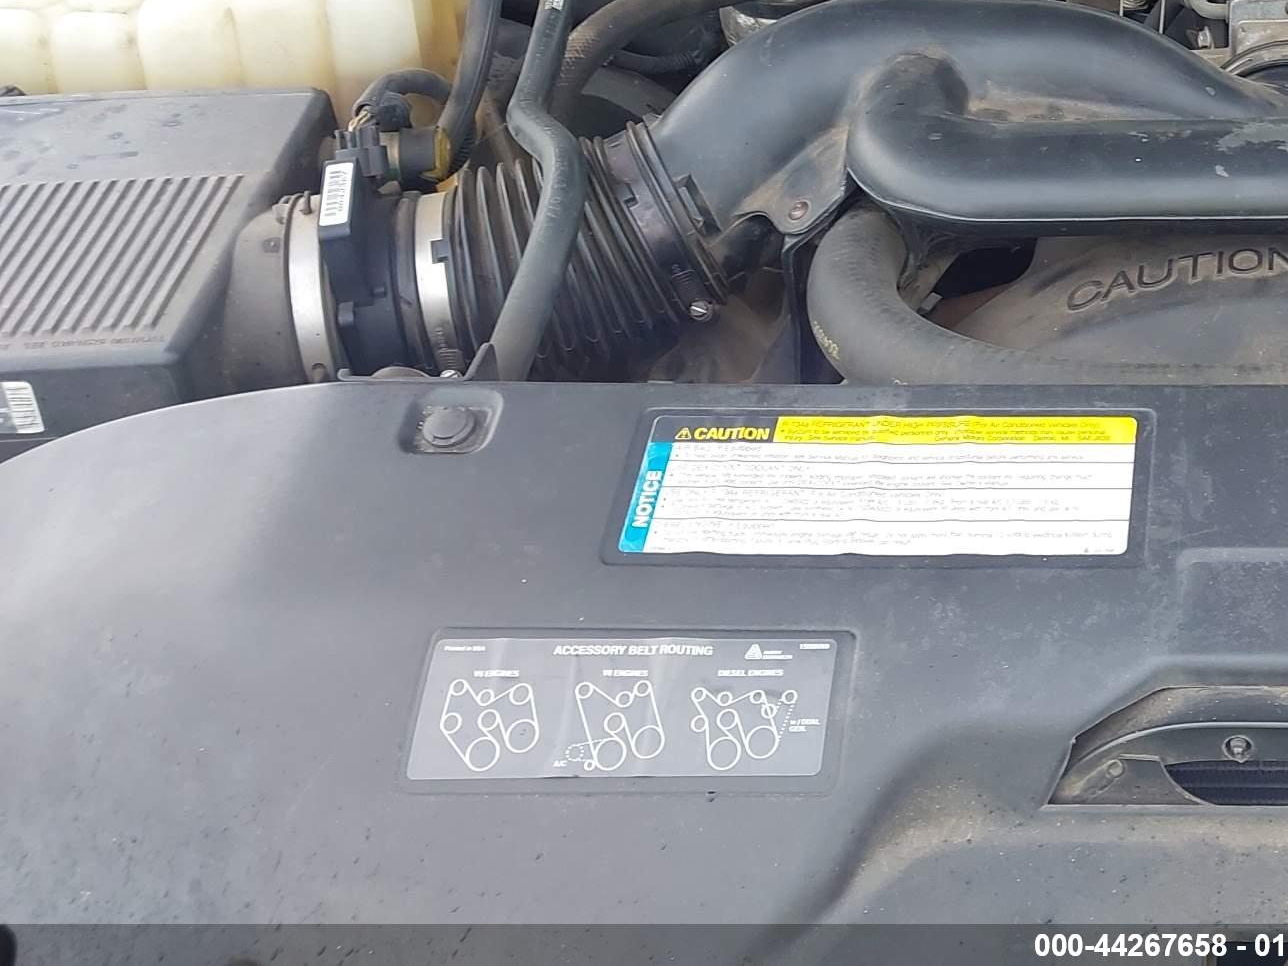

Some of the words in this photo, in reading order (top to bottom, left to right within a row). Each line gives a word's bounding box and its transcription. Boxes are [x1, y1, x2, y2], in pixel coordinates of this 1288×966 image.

[693, 427, 770, 441] CAUTION
[631, 471, 663, 528] NOTICE
[553, 645, 628, 656] ACCESSORY
[628, 645, 658, 656] BELT
[658, 645, 714, 656] ROUTING
